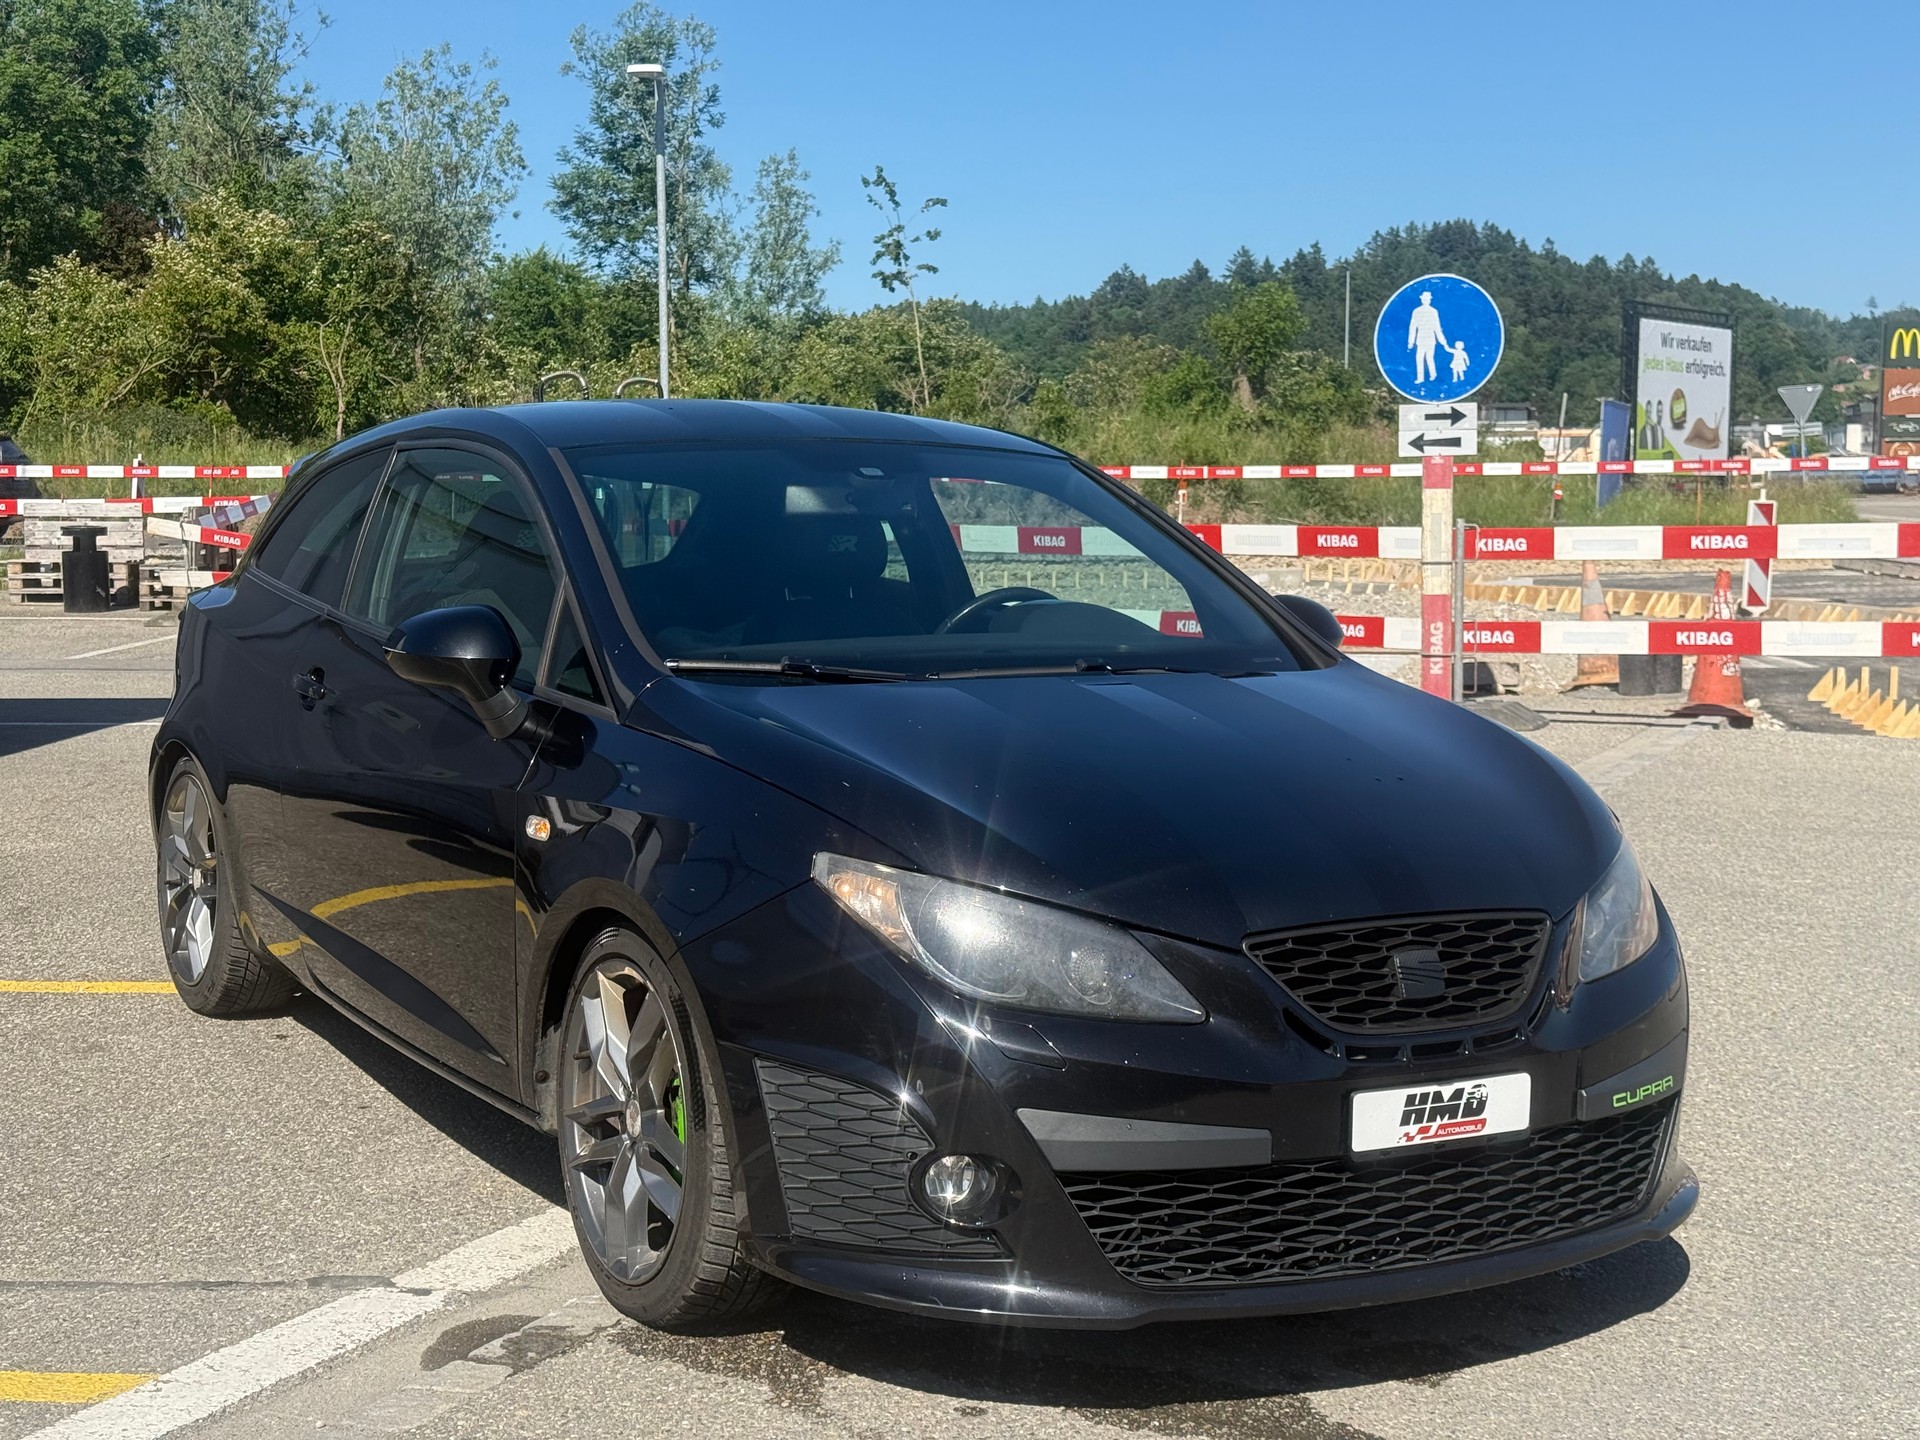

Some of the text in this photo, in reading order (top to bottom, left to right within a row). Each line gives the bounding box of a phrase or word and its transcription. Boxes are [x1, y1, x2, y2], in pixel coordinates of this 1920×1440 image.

[1660, 332, 1712, 353] Wir verkaufen
[1643, 353, 1727, 379] jedes Haus erfolgreich.
[213, 533, 241, 546] KIBAG
[1033, 535, 1066, 547] KIBAG
[1317, 534, 1359, 548] KIBAG
[1477, 538, 1528, 552] KIBAG
[1690, 535, 1749, 550] KIBAG
[1463, 630, 1515, 644] KIBAG
[1676, 631, 1734, 646] KIBAG
[1429, 621, 1444, 675] KIBAG
[1612, 1075, 1674, 1108] CUPRA
[1437, 1123, 1483, 1136] AUTOMOBILE
